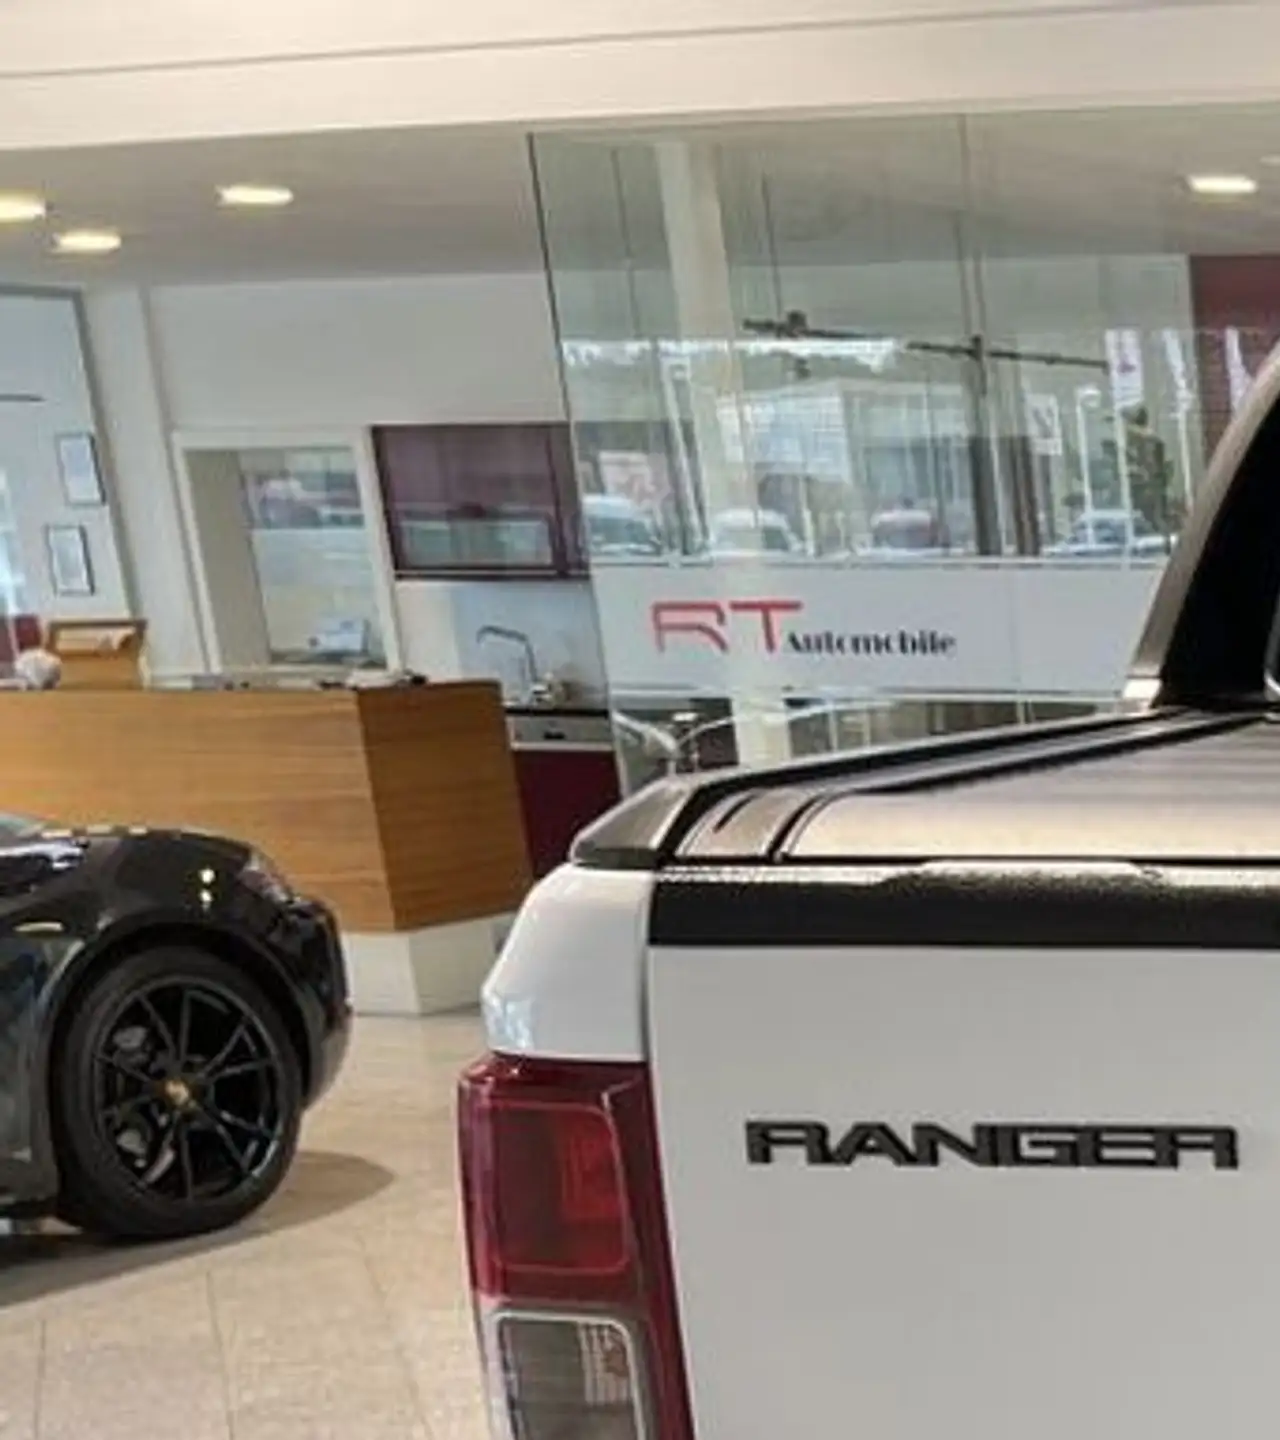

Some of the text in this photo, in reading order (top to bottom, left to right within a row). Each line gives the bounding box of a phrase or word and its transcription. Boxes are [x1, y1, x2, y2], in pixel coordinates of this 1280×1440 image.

[650, 600, 957, 655] RT Automobile
[745, 1121, 1238, 1169] RANGER
